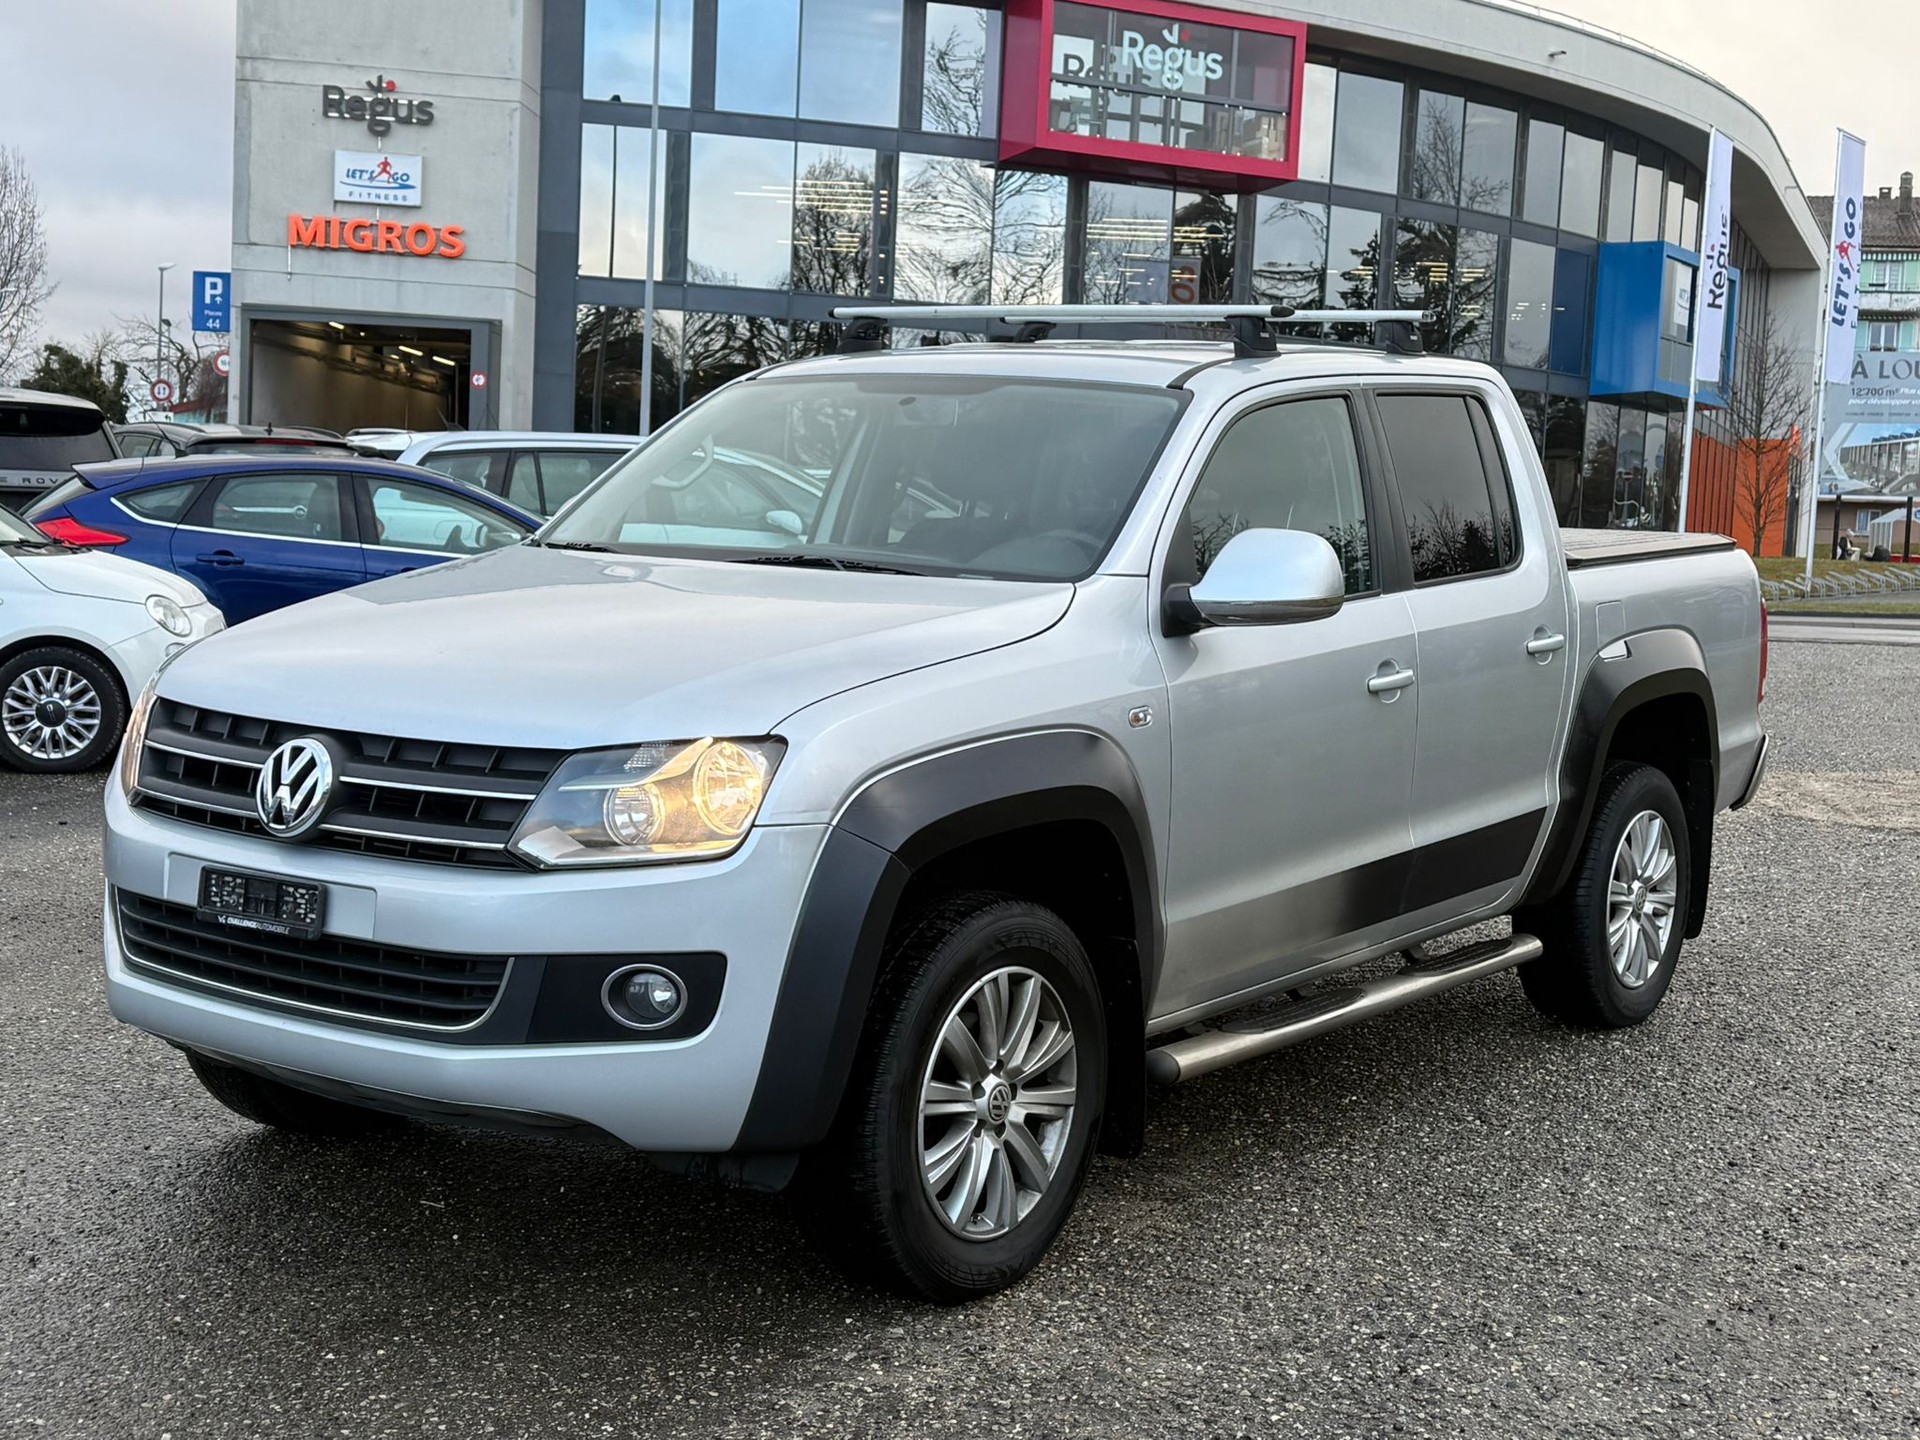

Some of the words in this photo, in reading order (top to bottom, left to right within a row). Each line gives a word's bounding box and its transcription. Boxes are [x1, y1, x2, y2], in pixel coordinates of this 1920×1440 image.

[1121, 28, 1223, 90] Regus
[322, 82, 434, 137] Regus
[346, 168, 375, 182] LET'S
[391, 173, 410, 182] GO
[348, 191, 408, 202] FITNESS
[288, 213, 466, 259] MIGROS
[1831, 262, 1852, 327] LET'S
[1844, 197, 1856, 239] GO
[204, 276, 223, 304] P
[206, 318, 220, 329] 44
[1851, 353, 1868, 379] À
